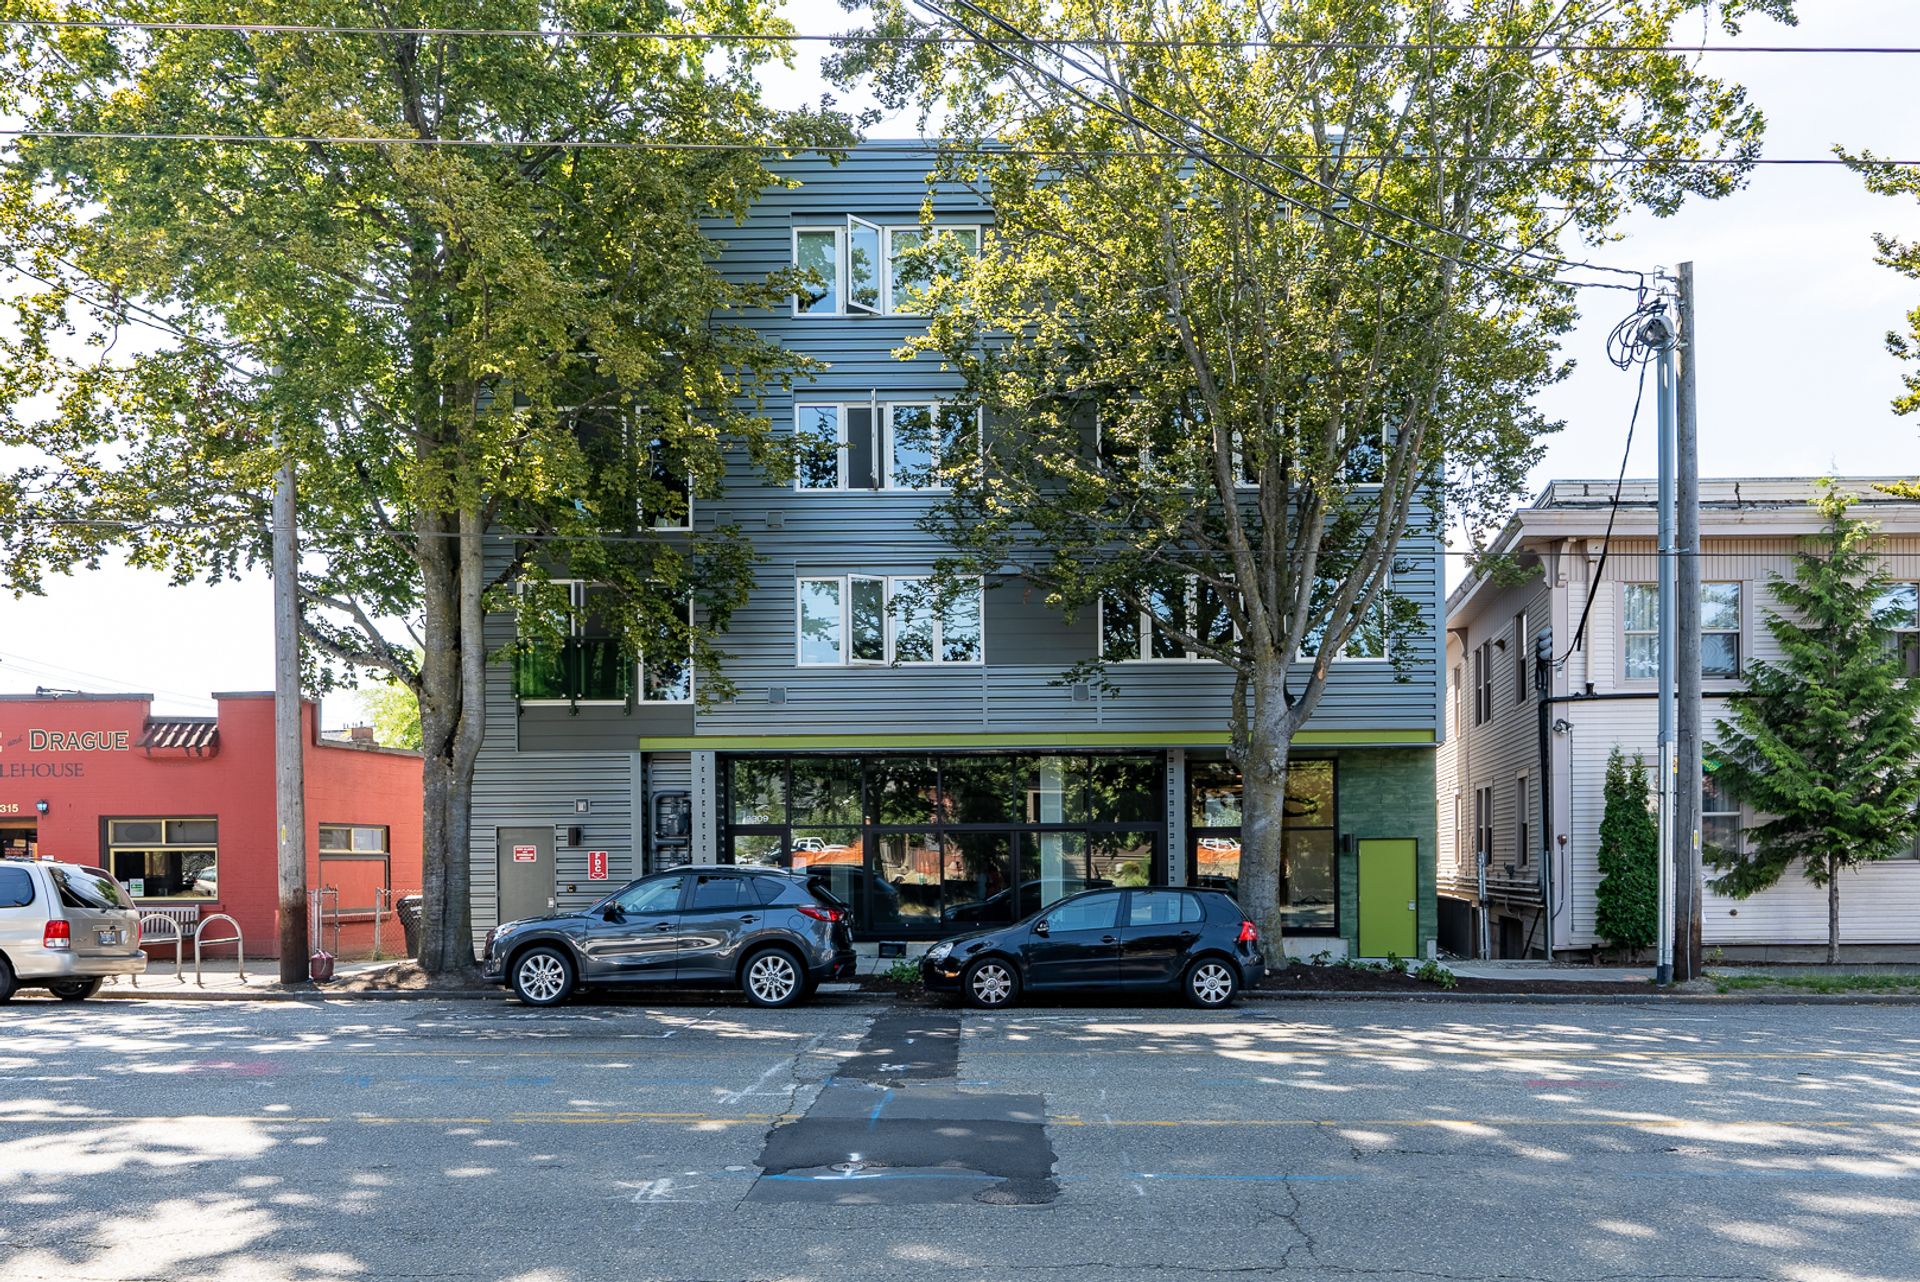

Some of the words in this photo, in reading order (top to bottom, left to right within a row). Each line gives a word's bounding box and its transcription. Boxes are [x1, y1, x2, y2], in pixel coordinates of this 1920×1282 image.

[29, 729, 129, 751] DRAGUE
[0, 762, 85, 778] LEHOUSE
[0, 803, 19, 813] 315
[594, 851, 602, 873] FDC
